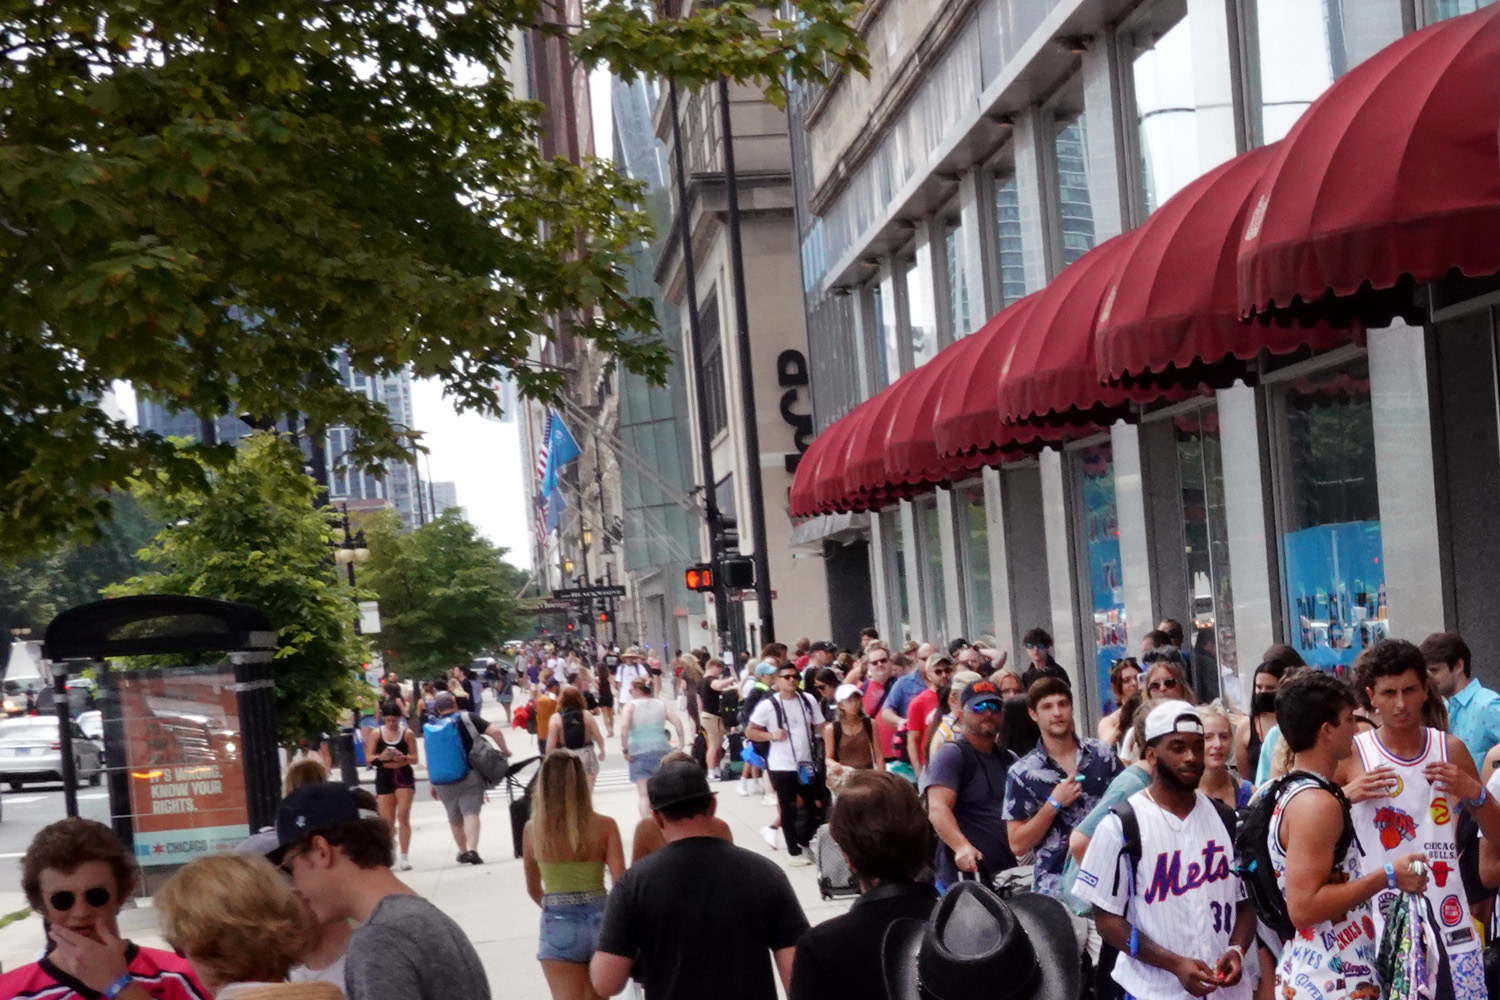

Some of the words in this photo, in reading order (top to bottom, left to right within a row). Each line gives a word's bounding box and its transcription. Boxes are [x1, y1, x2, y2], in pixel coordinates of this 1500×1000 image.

[151, 782, 188, 799] KNOW
[190, 780, 223, 796] YOUR
[152, 798, 198, 814] RIGHTS.
[166, 839, 208, 854] CHICAGO
[1424, 842, 1455, 851] CHICAG
[1144, 839, 1230, 905] Mets
